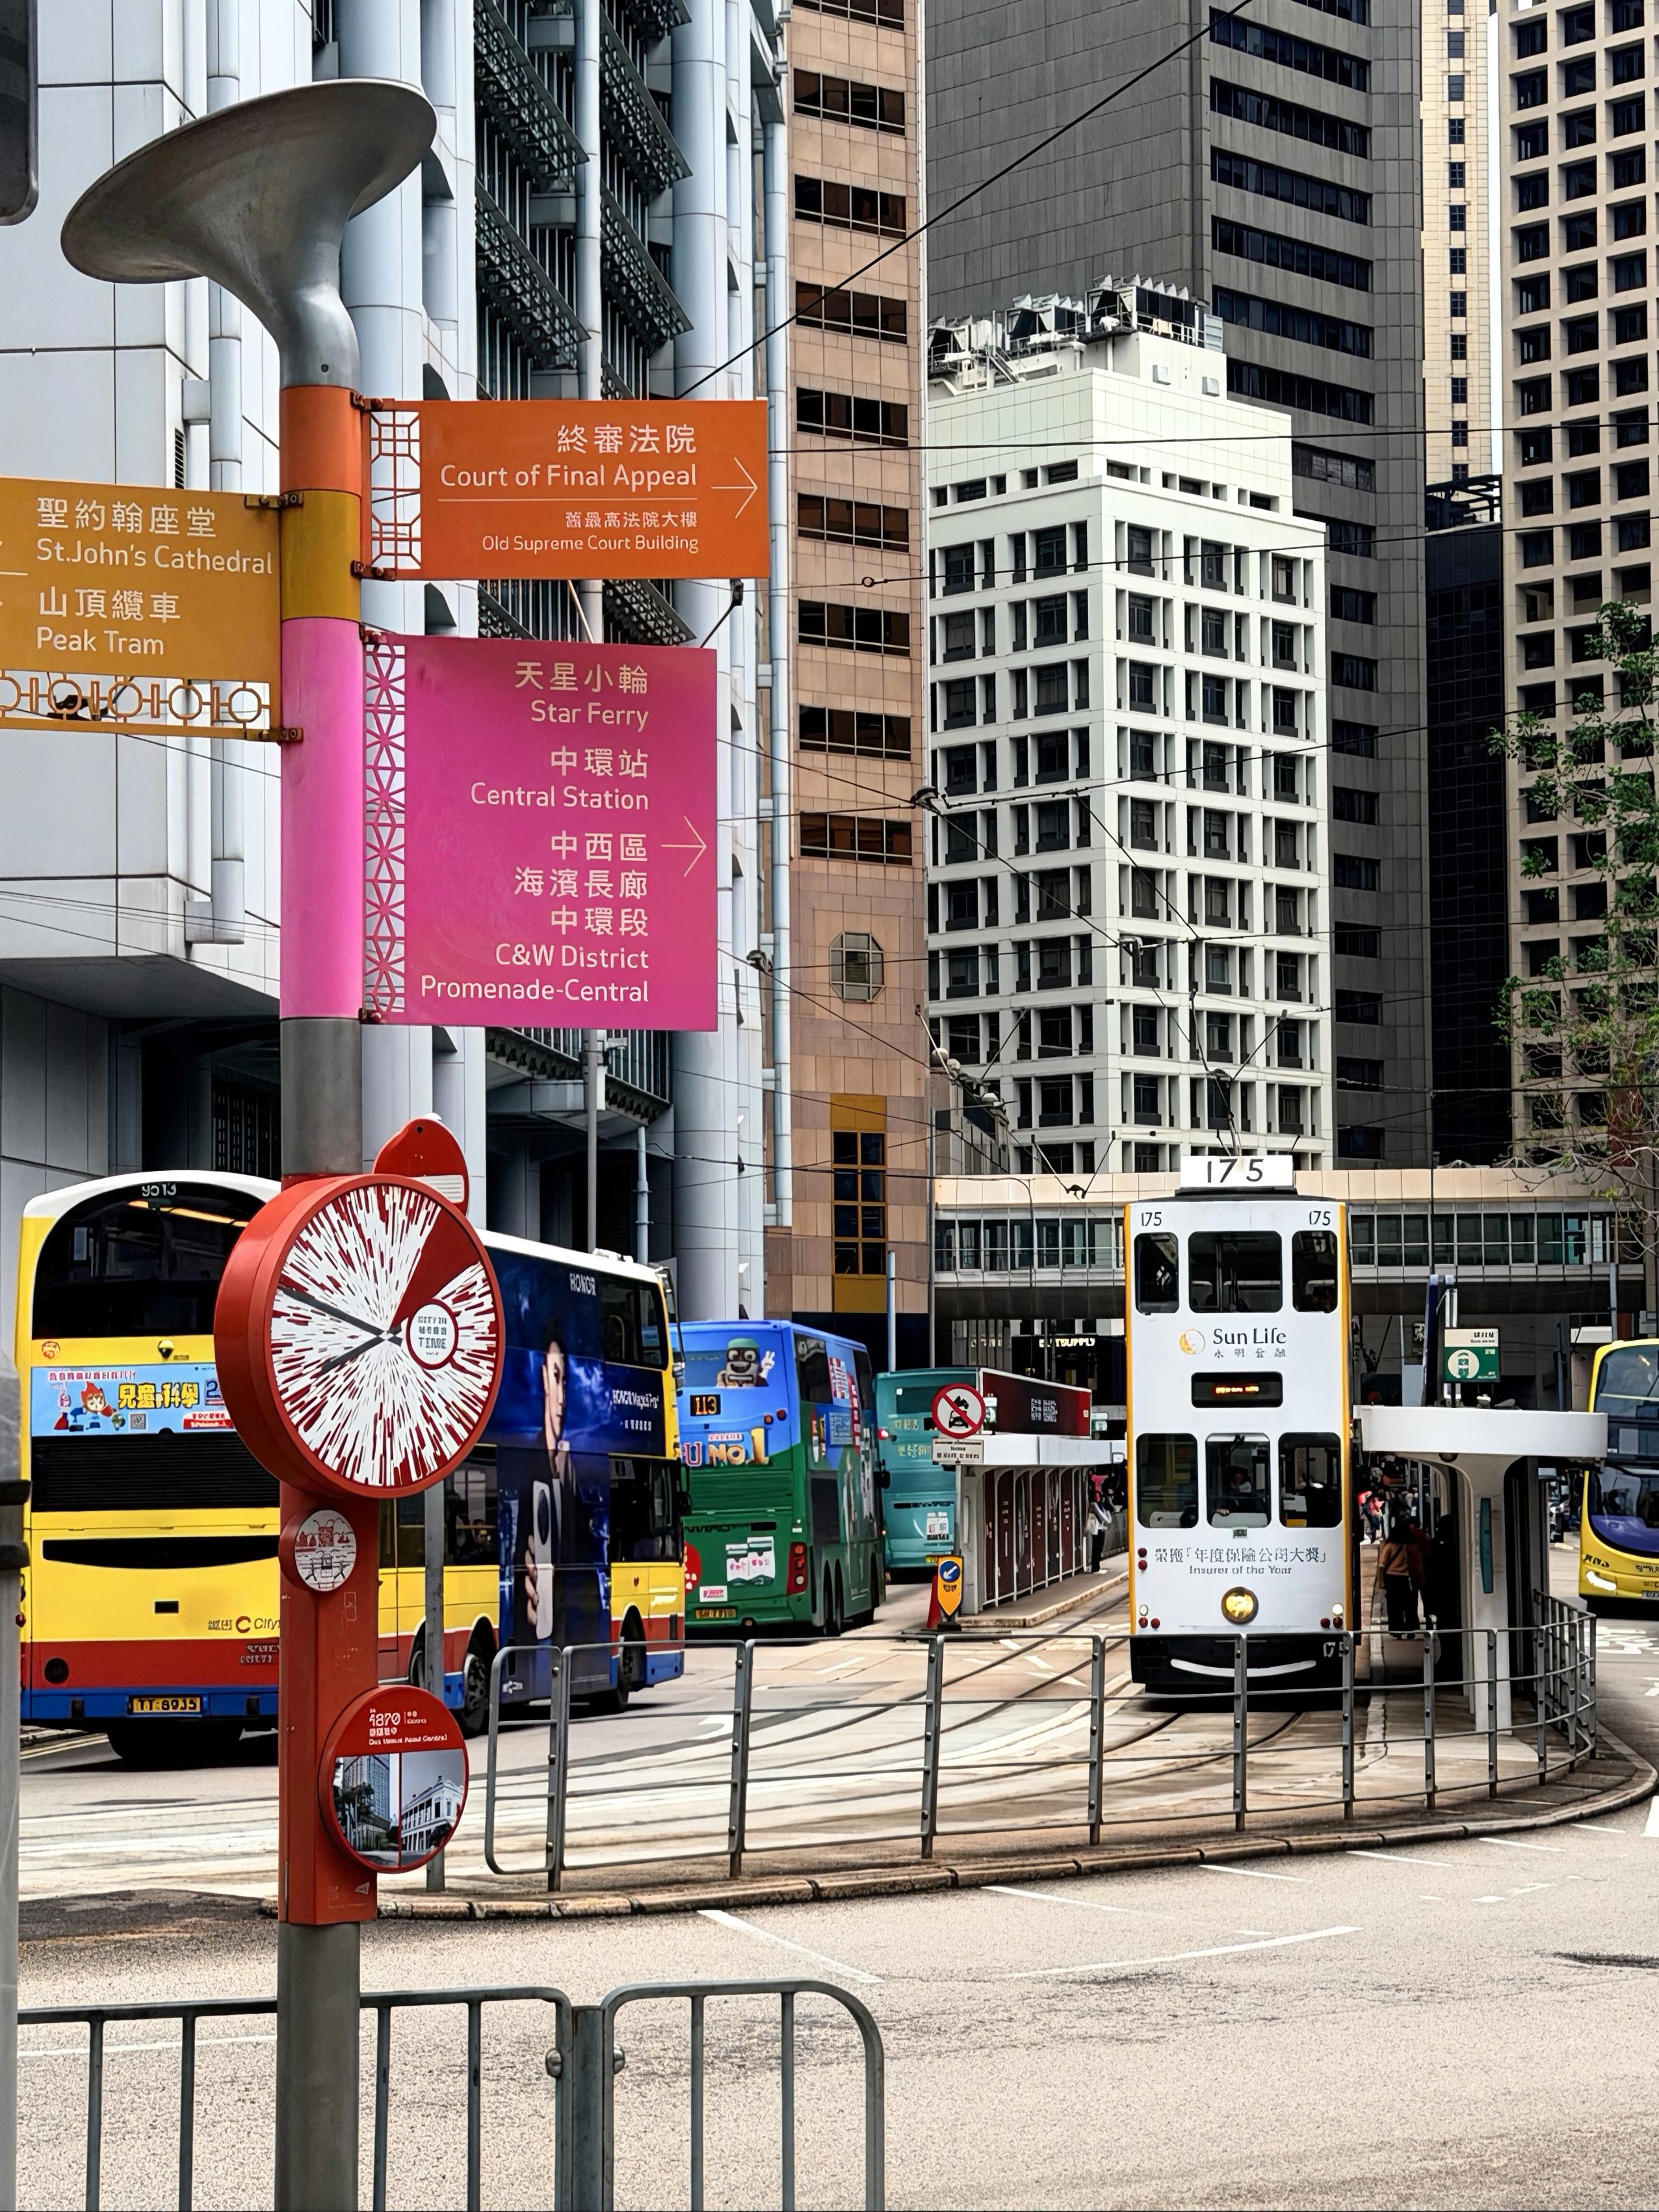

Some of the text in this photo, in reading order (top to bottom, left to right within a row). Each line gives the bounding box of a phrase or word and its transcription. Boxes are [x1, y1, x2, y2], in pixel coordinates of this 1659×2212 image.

[557, 423, 696, 454] 終審法院
[441, 463, 696, 492] Court of Final Appeal
[37, 497, 216, 537] 聖約翰座堂
[482, 534, 699, 555] Old Supreme Court Building
[154, 545, 272, 574] Cathedral
[40, 586, 181, 623] 山頂纜車
[37, 626, 164, 655] Peak Tram
[515, 662, 647, 694] 天星小輪
[531, 700, 649, 733] Star Ferry
[551, 746, 648, 778] 中環站
[471, 782, 648, 810] Central Station
[551, 830, 647, 862] 中西區
[514, 867, 647, 900] 海濱長廊
[551, 904, 648, 936] 中環段
[496, 943, 649, 969] C&W District
[421, 975, 649, 1002] Promenade-Central
[1207, 1158, 1264, 1183] 175
[1141, 1211, 1162, 1227] 175
[1309, 1210, 1331, 1226] 175
[1213, 1327, 1287, 1345] Sun Life
[695, 1395, 718, 1416] 113
[1190, 1565, 1292, 1575] Insurer of the Year
